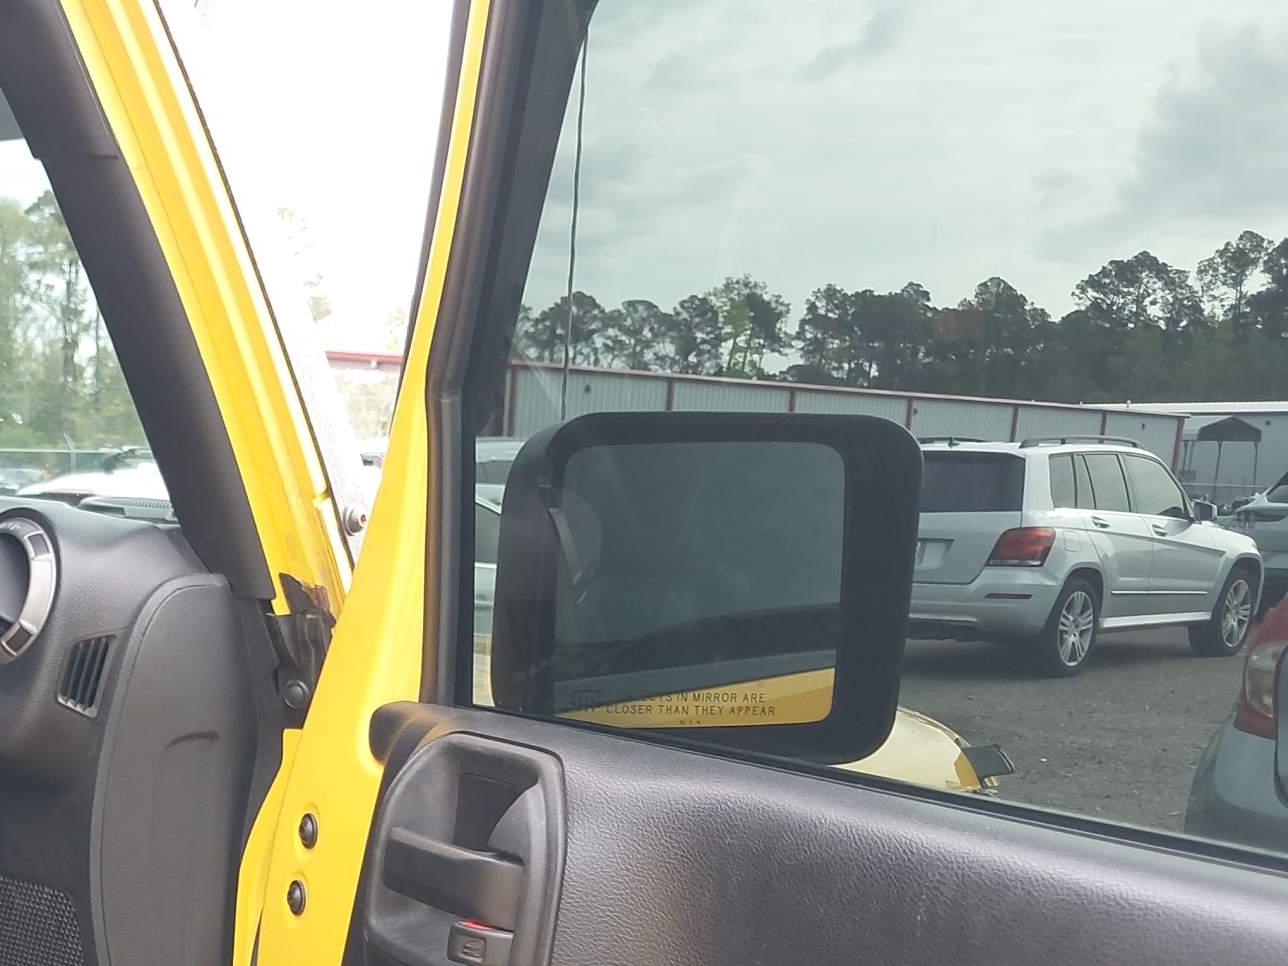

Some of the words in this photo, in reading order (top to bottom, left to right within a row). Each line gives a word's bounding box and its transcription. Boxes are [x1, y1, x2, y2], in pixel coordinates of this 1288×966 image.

[675, 692, 689, 703] IN
[693, 692, 739, 704] MIRROR
[743, 692, 767, 704] ARE
[606, 704, 653, 715] CLOSER
[658, 704, 688, 715] THAN
[695, 704, 723, 716] THEY
[729, 705, 777, 717] APPEAR
